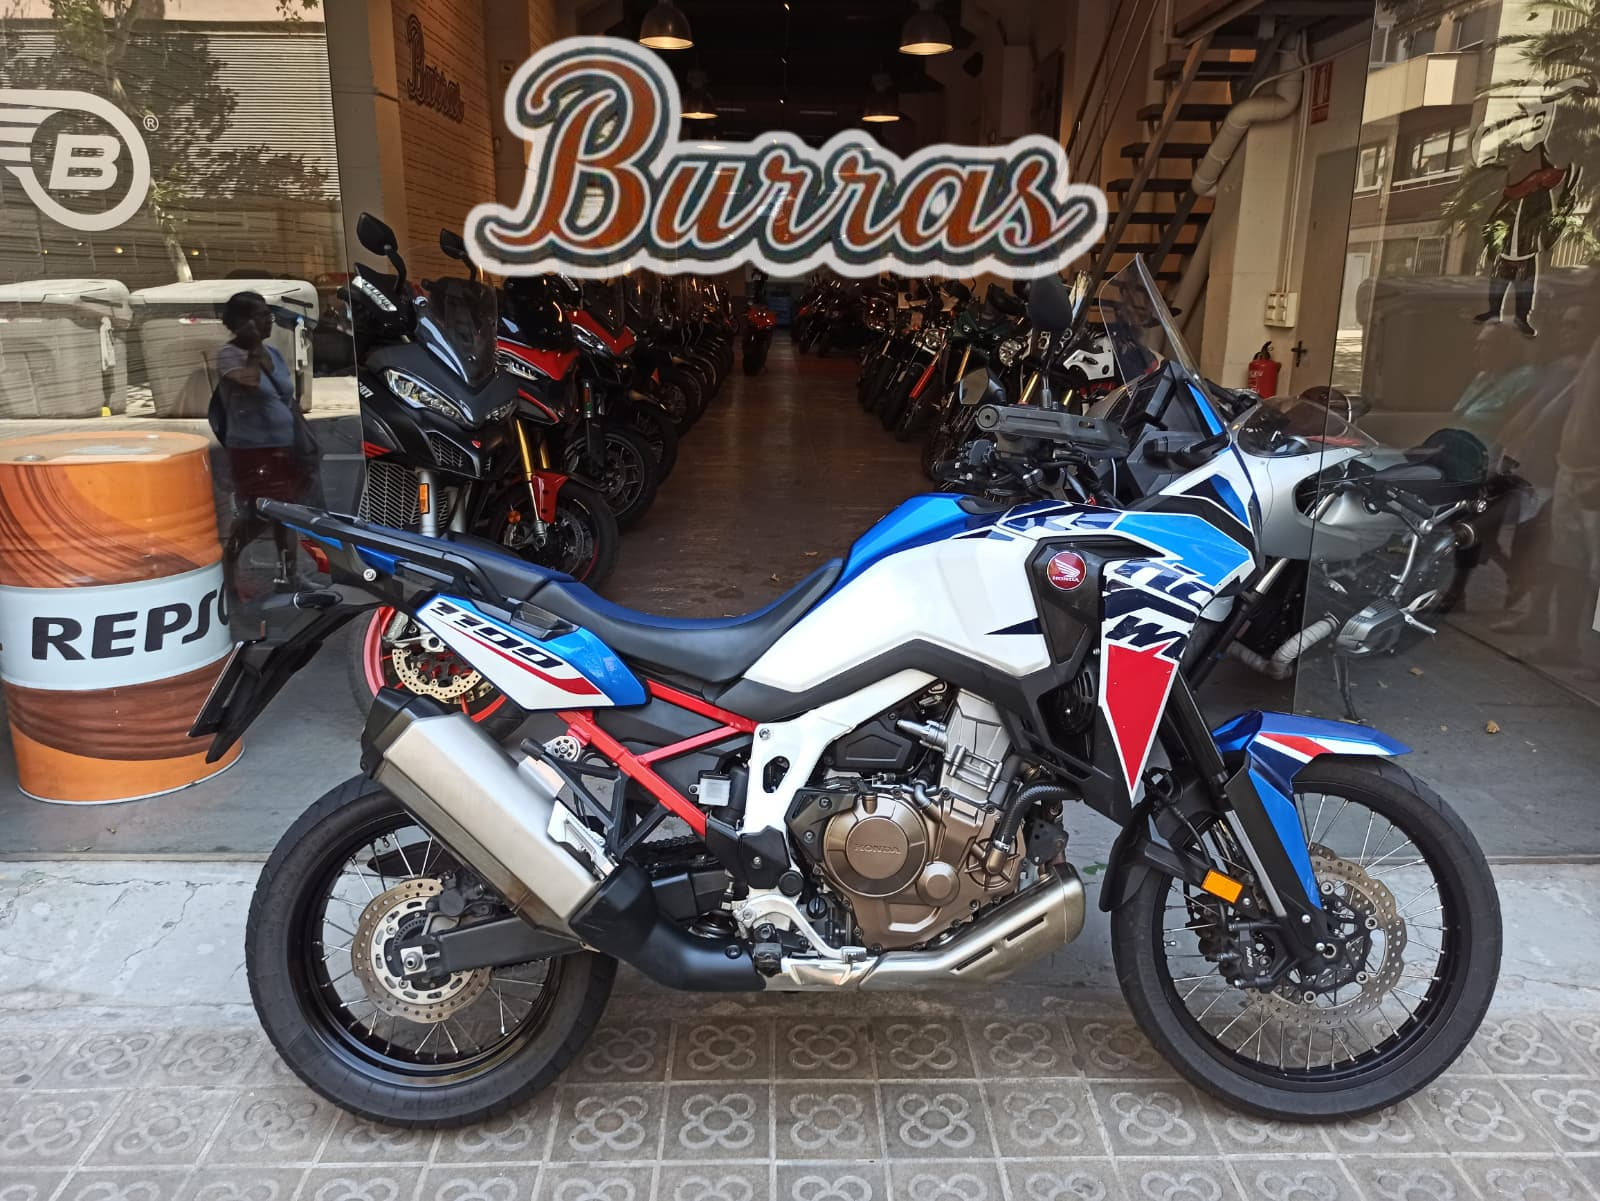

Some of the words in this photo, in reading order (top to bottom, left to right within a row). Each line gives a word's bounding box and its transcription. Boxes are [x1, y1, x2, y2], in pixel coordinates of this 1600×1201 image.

[48, 133, 121, 191] B
[1052, 575, 1080, 583] HONDA
[429, 601, 564, 669] 1100
[854, 842, 902, 856] HONDA
